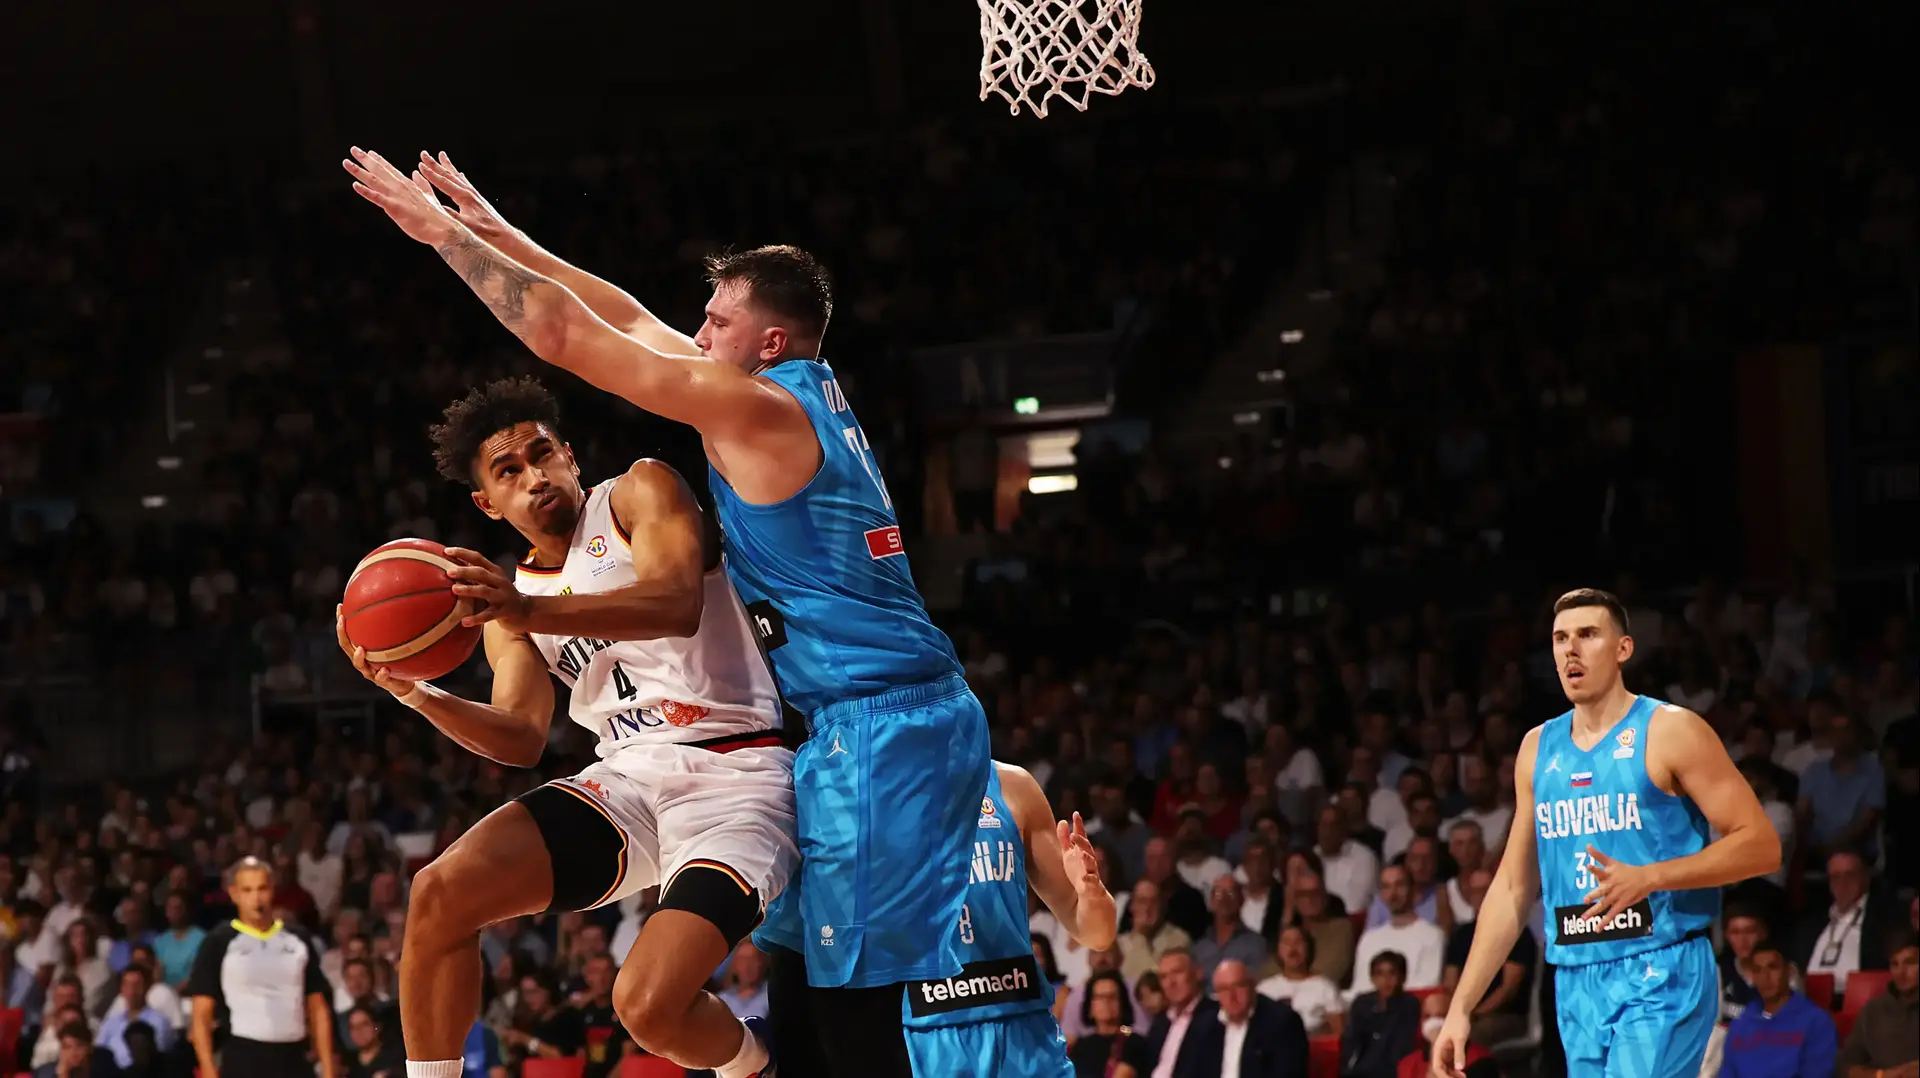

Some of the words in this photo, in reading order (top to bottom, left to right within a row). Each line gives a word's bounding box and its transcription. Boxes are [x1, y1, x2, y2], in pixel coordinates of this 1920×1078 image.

[611, 660, 638, 702] 4
[607, 708, 665, 740] ING
[1536, 793, 1643, 839] SLOVENIJA
[969, 840, 1015, 885] NIJA
[820, 938, 834, 946] KZS
[921, 968, 1028, 1003] telemach
